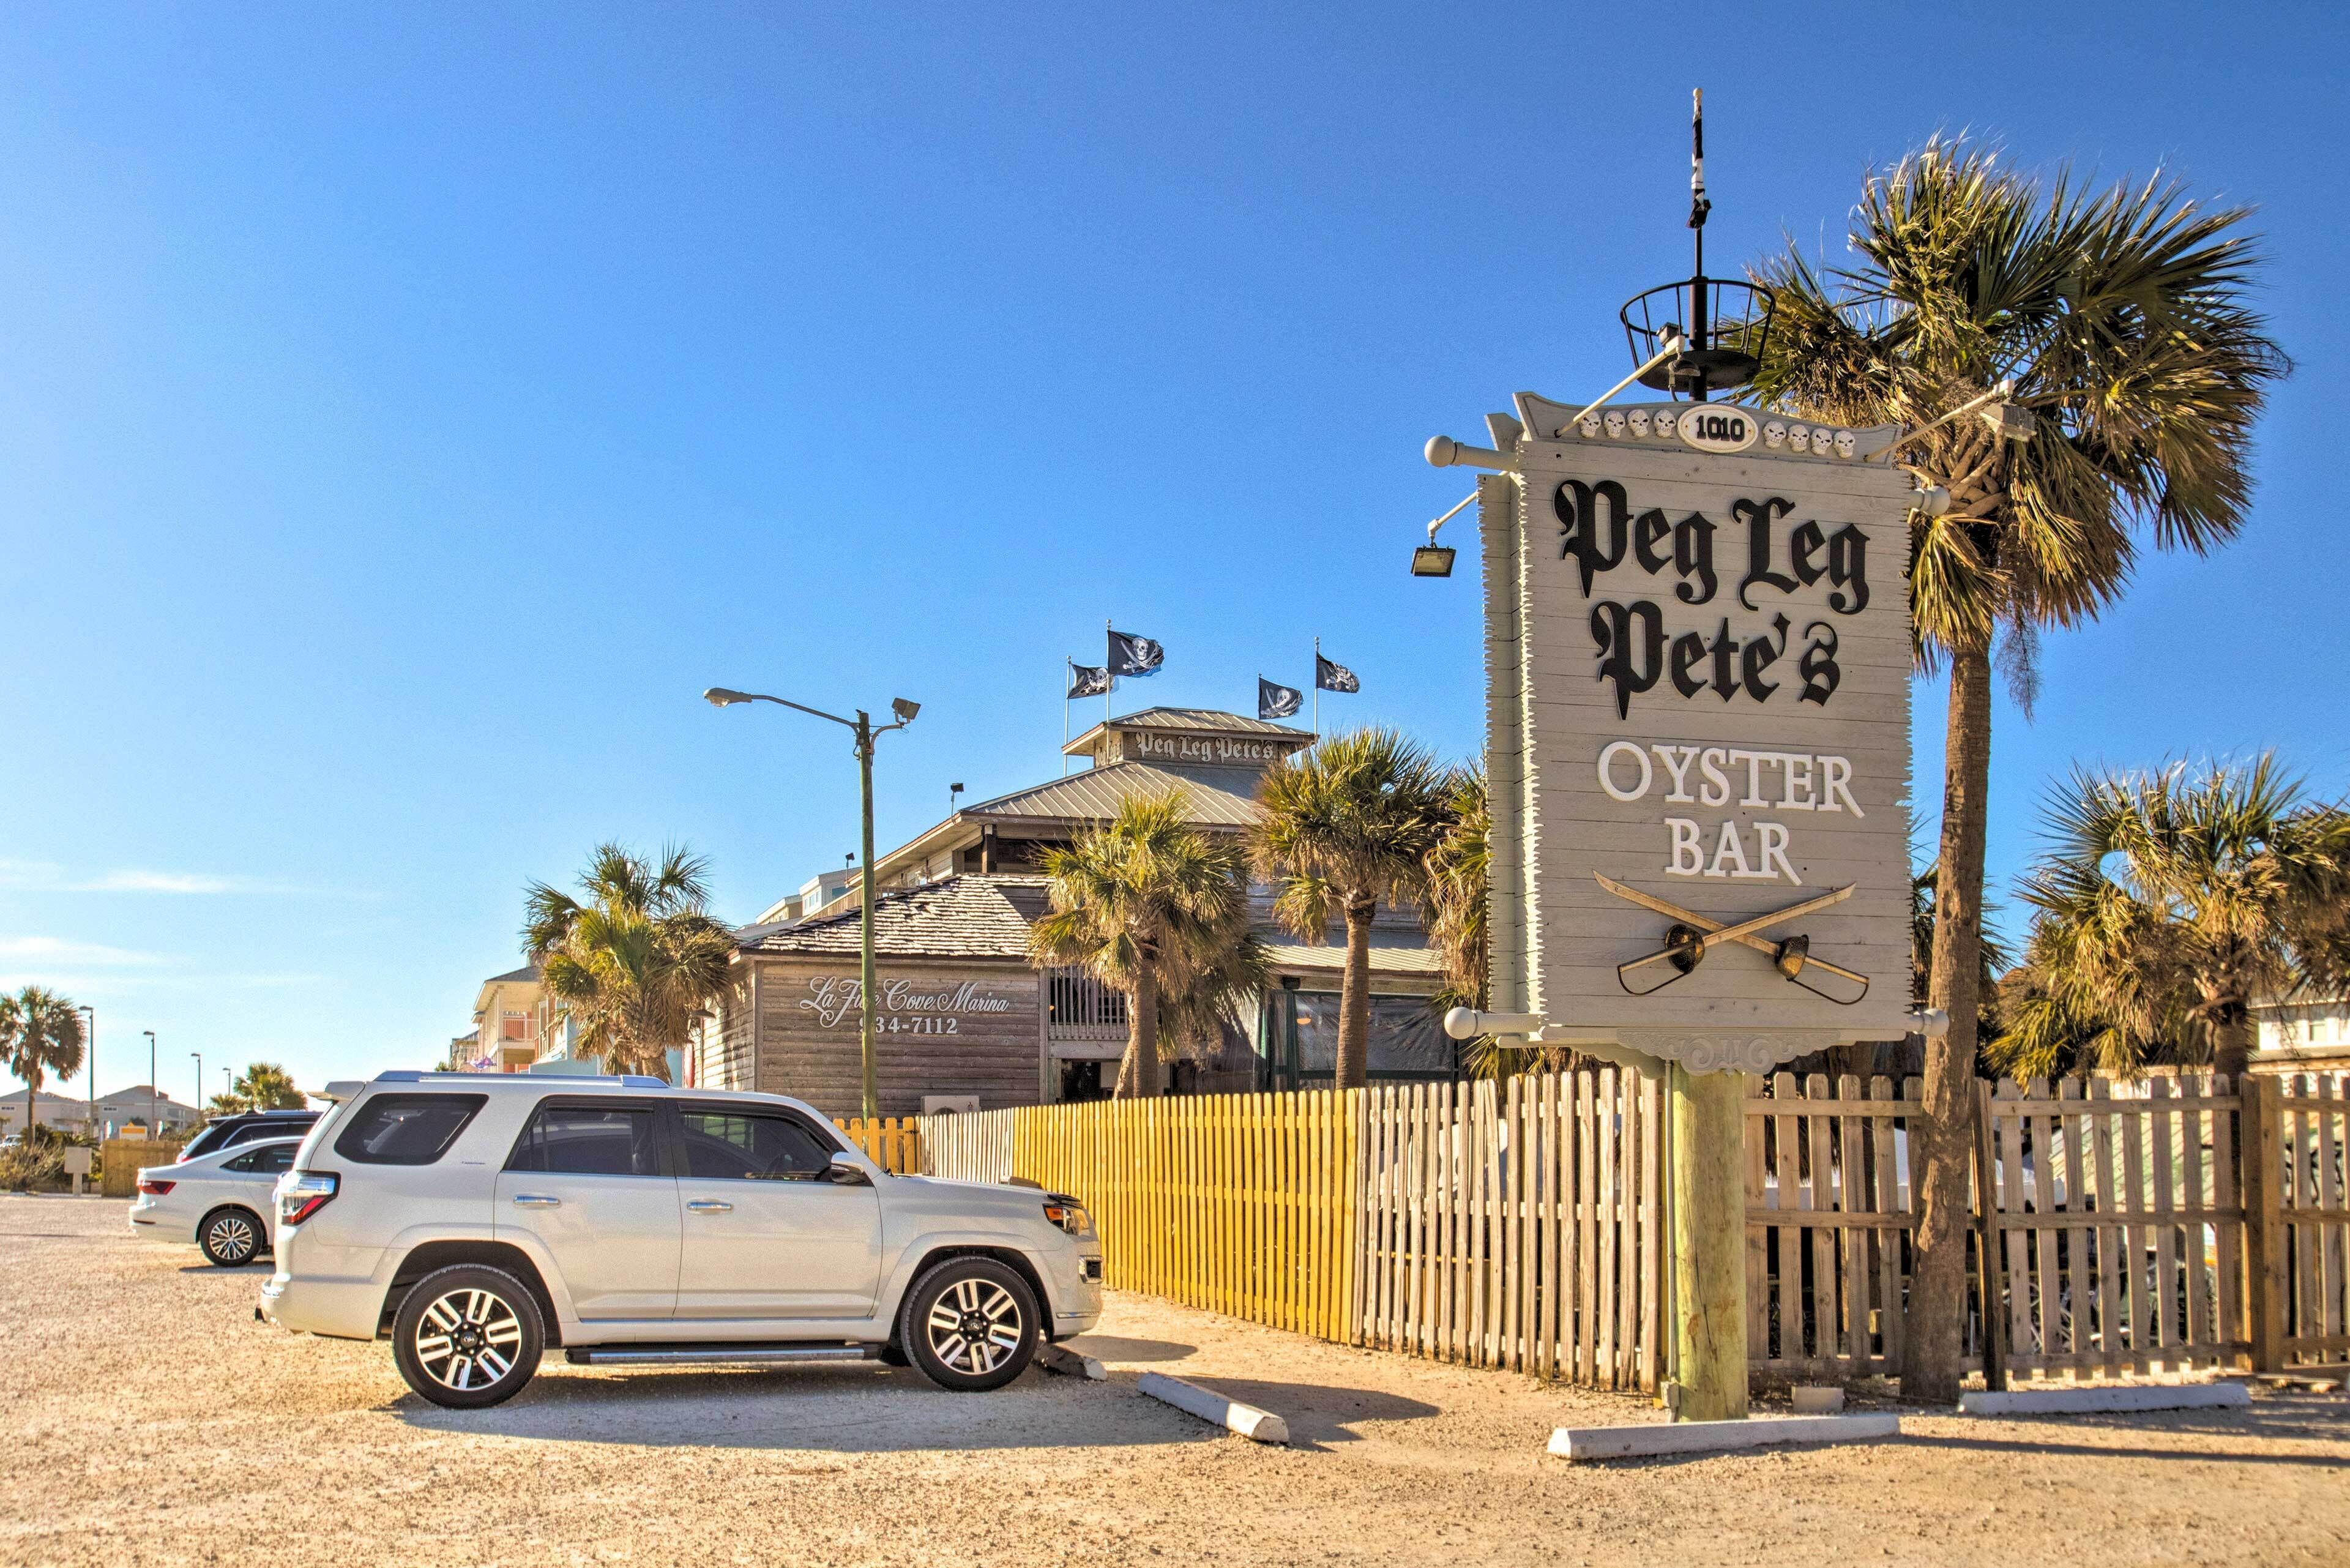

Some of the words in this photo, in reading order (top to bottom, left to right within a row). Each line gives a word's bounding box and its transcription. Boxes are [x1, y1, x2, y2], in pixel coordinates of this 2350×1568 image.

[1696, 415, 1745, 442] 1010
[1553, 480, 1718, 606] Peg
[1731, 496, 1871, 614] Leg
[1591, 600, 1841, 720] Pete's
[1136, 731, 1175, 759] Peg
[1178, 736, 1212, 762] Leg
[1215, 737, 1274, 764] Pete's
[1597, 741, 1865, 818] OYSTER
[1665, 817, 1803, 886] BAR
[799, 976, 838, 1018] La
[883, 979, 936, 1011] Cove
[937, 982, 1010, 1014] Marina
